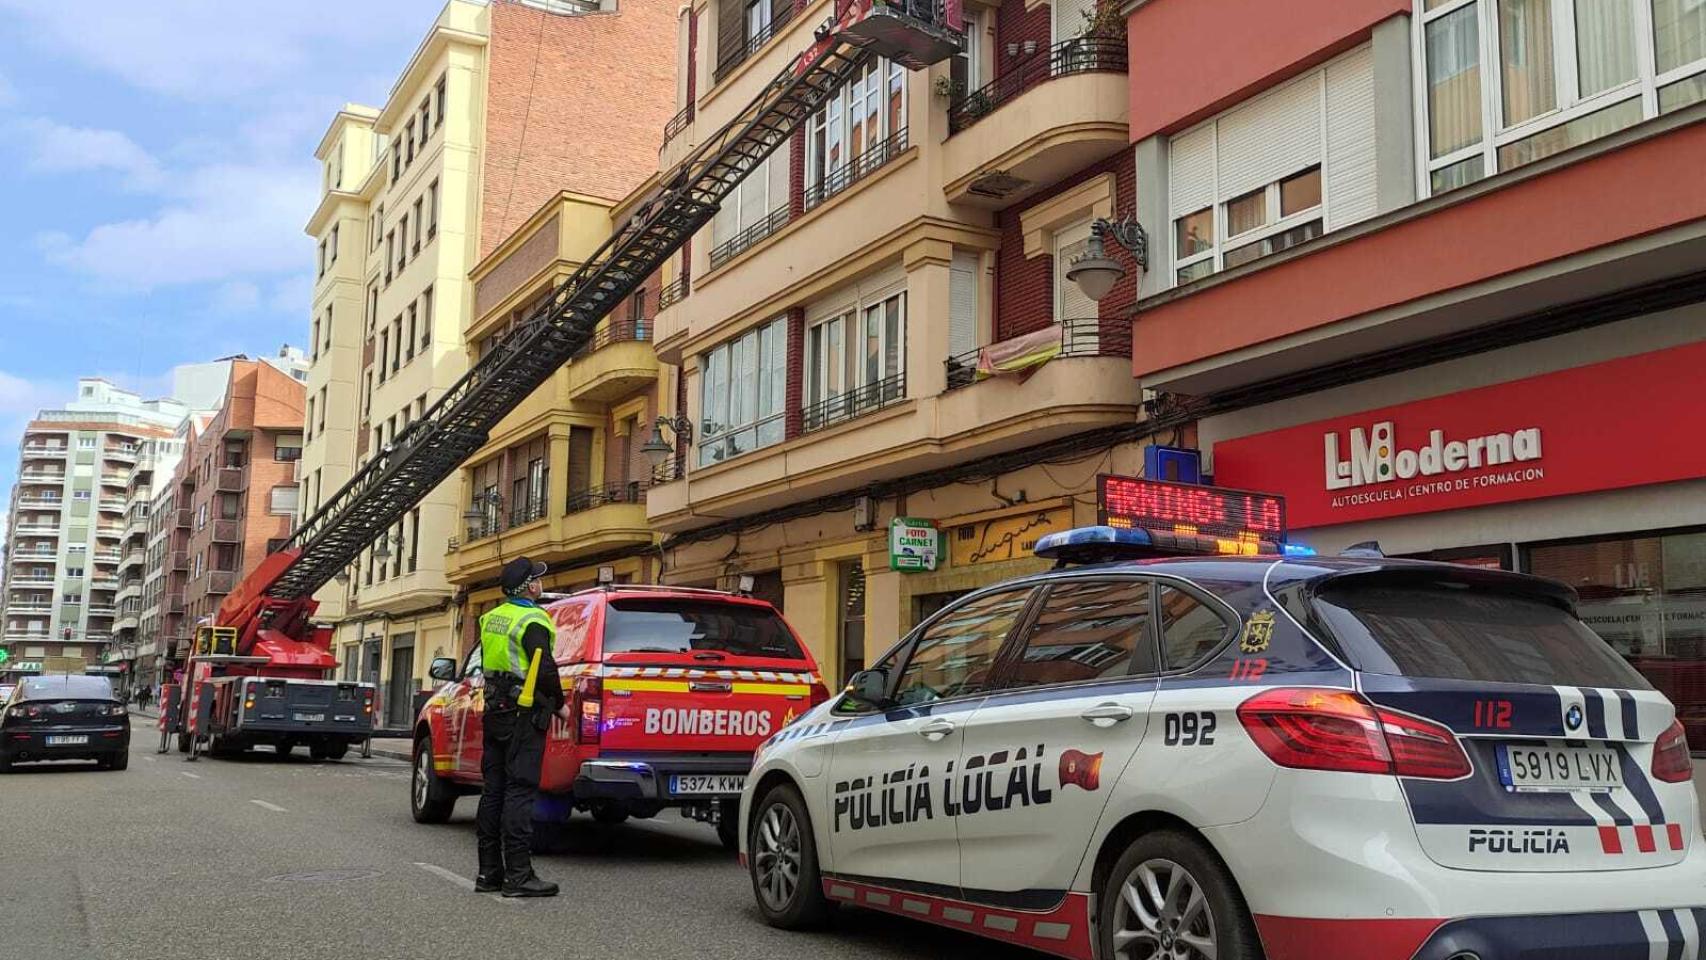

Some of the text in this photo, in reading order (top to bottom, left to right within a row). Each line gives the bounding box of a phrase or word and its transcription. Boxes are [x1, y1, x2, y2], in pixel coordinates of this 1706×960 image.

[1332, 467, 1544, 508] AUTOESCUELA CENTRO DE FORMACION
[1246, 495, 1281, 532] LA
[900, 537, 933, 547] CARNET
[906, 529, 928, 538] FOTO
[1229, 656, 1267, 681] 112
[644, 707, 772, 737] BOMBEROS
[1474, 700, 1513, 728] 112
[1164, 711, 1218, 747] 092
[1512, 750, 1618, 782] 5919 LVX
[680, 777, 714, 791] 5374
[834, 743, 1052, 833] POLICÍA LOCAL
[1468, 829, 1570, 853] POLICÍA
